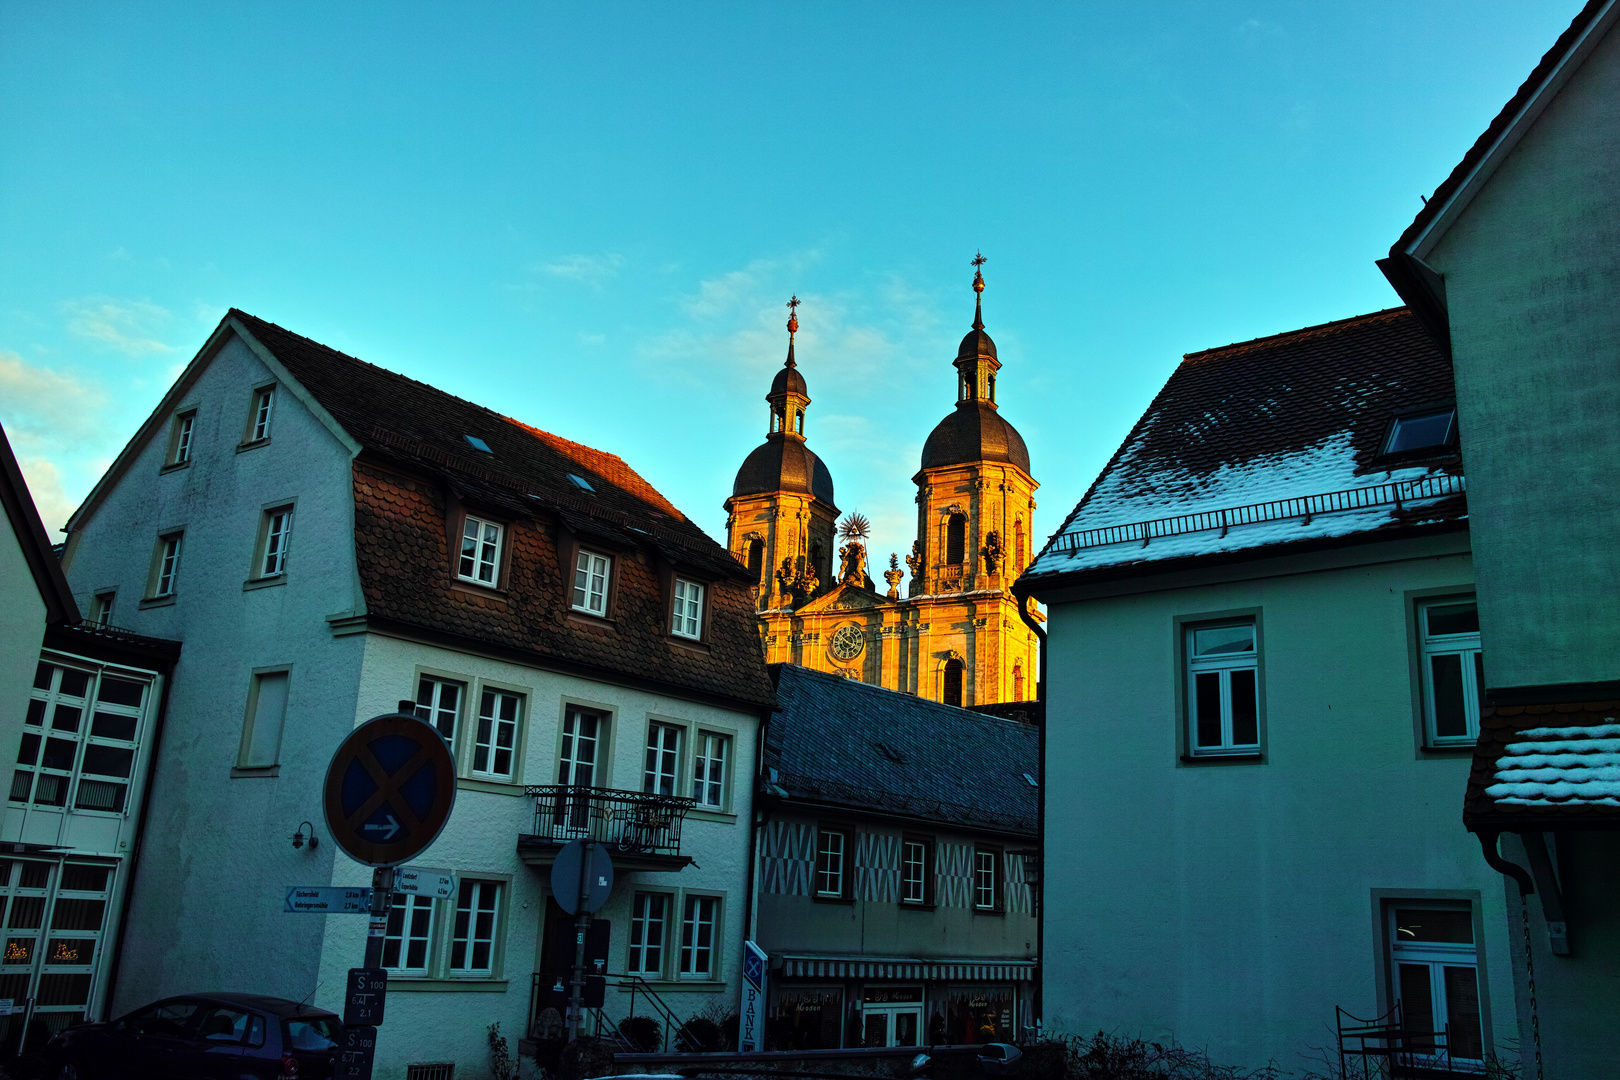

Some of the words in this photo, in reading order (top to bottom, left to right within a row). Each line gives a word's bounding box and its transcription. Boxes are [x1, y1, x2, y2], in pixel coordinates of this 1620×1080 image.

[295, 901, 328, 910] Behringersmühle
[358, 976, 366, 989] S
[744, 988, 756, 1040] BANK
[348, 1033, 355, 1046] S
[359, 1040, 372, 1048] 100
